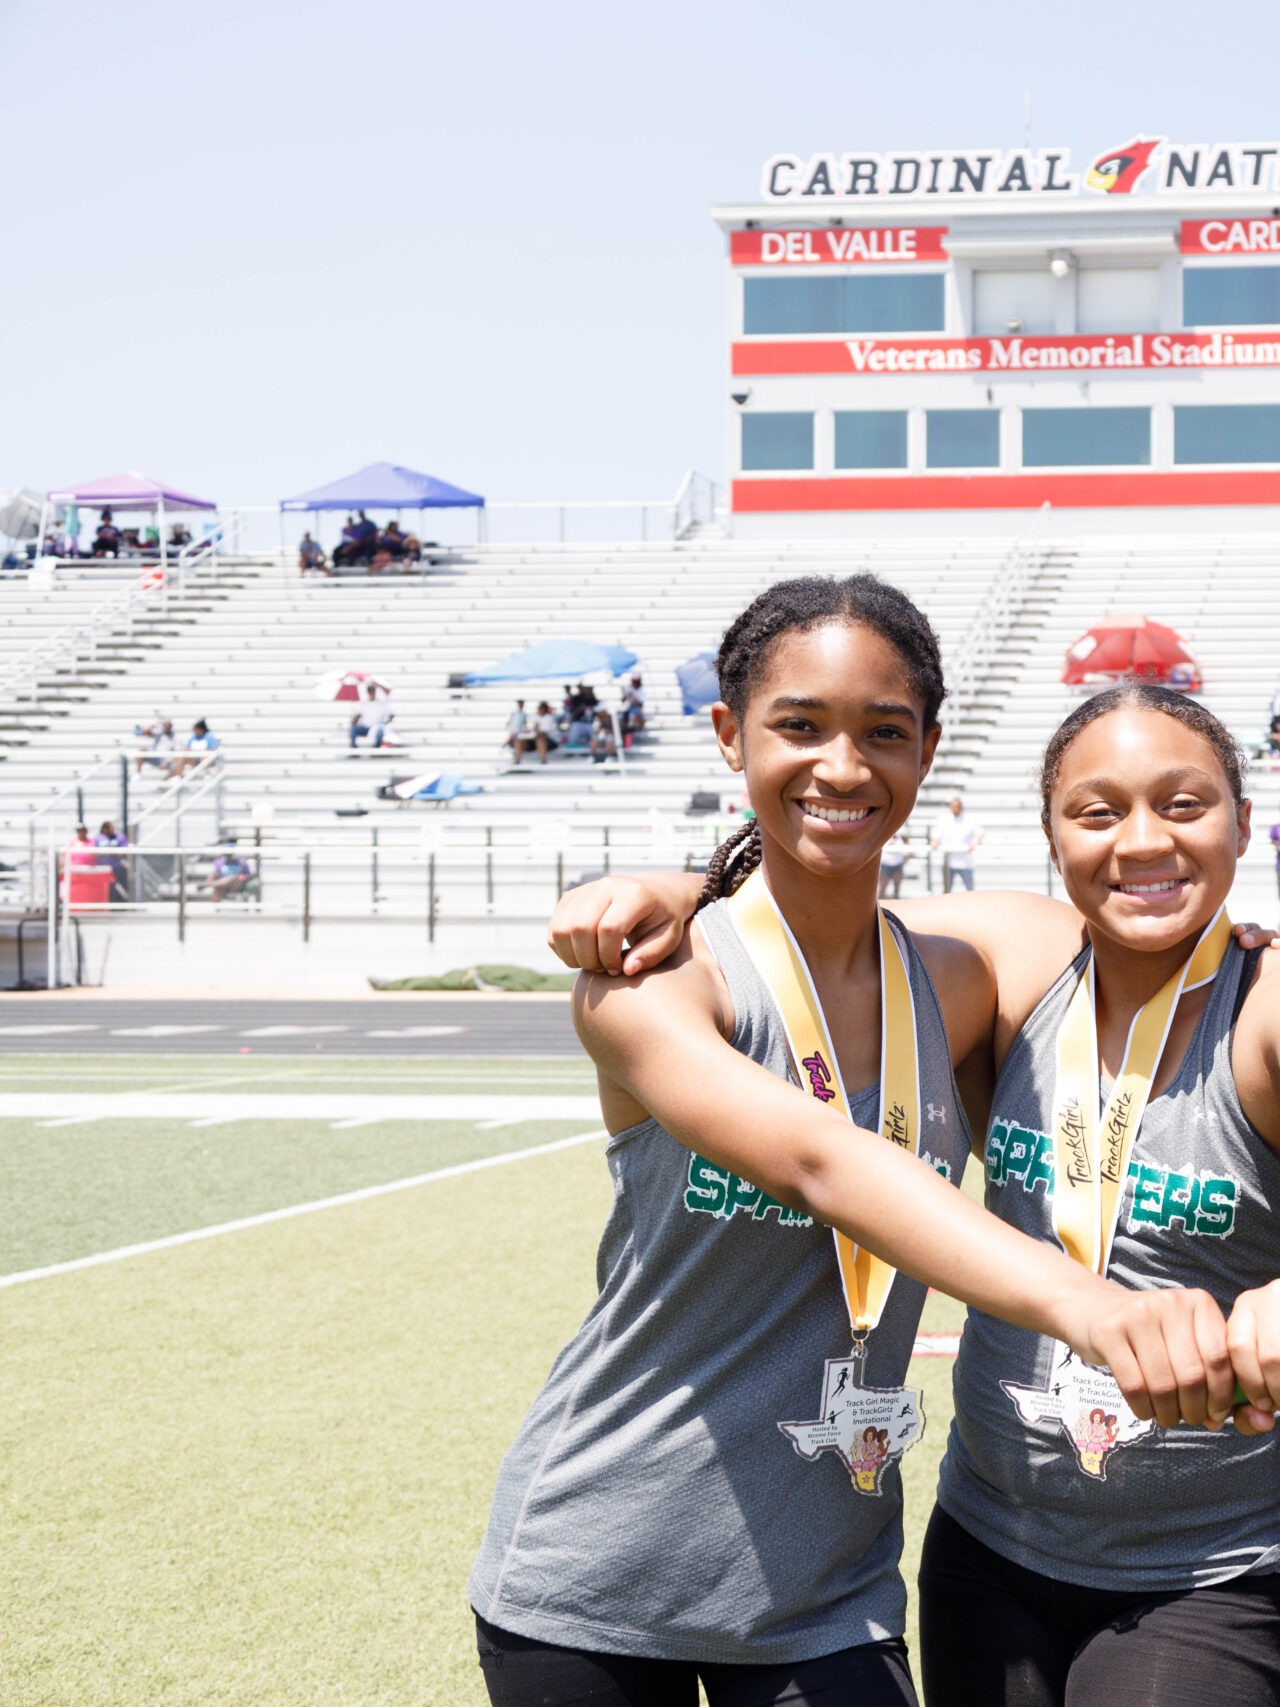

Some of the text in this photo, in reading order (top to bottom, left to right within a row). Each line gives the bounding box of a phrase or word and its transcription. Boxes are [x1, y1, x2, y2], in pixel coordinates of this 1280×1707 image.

[768, 154, 1071, 197] CARDINAL
[760, 229, 917, 262] DEL VALLE
[845, 340, 983, 371] Veterans
[986, 335, 1145, 369] Memorial
[1058, 1095, 1093, 1188] TrackGirlz
[1100, 1092, 1134, 1184] TrackGirlz
[1072, 1376, 1091, 1385] Track
[1094, 1379, 1107, 1388] Girl
[845, 1397, 900, 1408] Track Girl Magic
[859, 1406, 893, 1415] TrackGirlz
[1078, 1396, 1121, 1409] Invitational
[852, 1415, 891, 1425] Invitational
